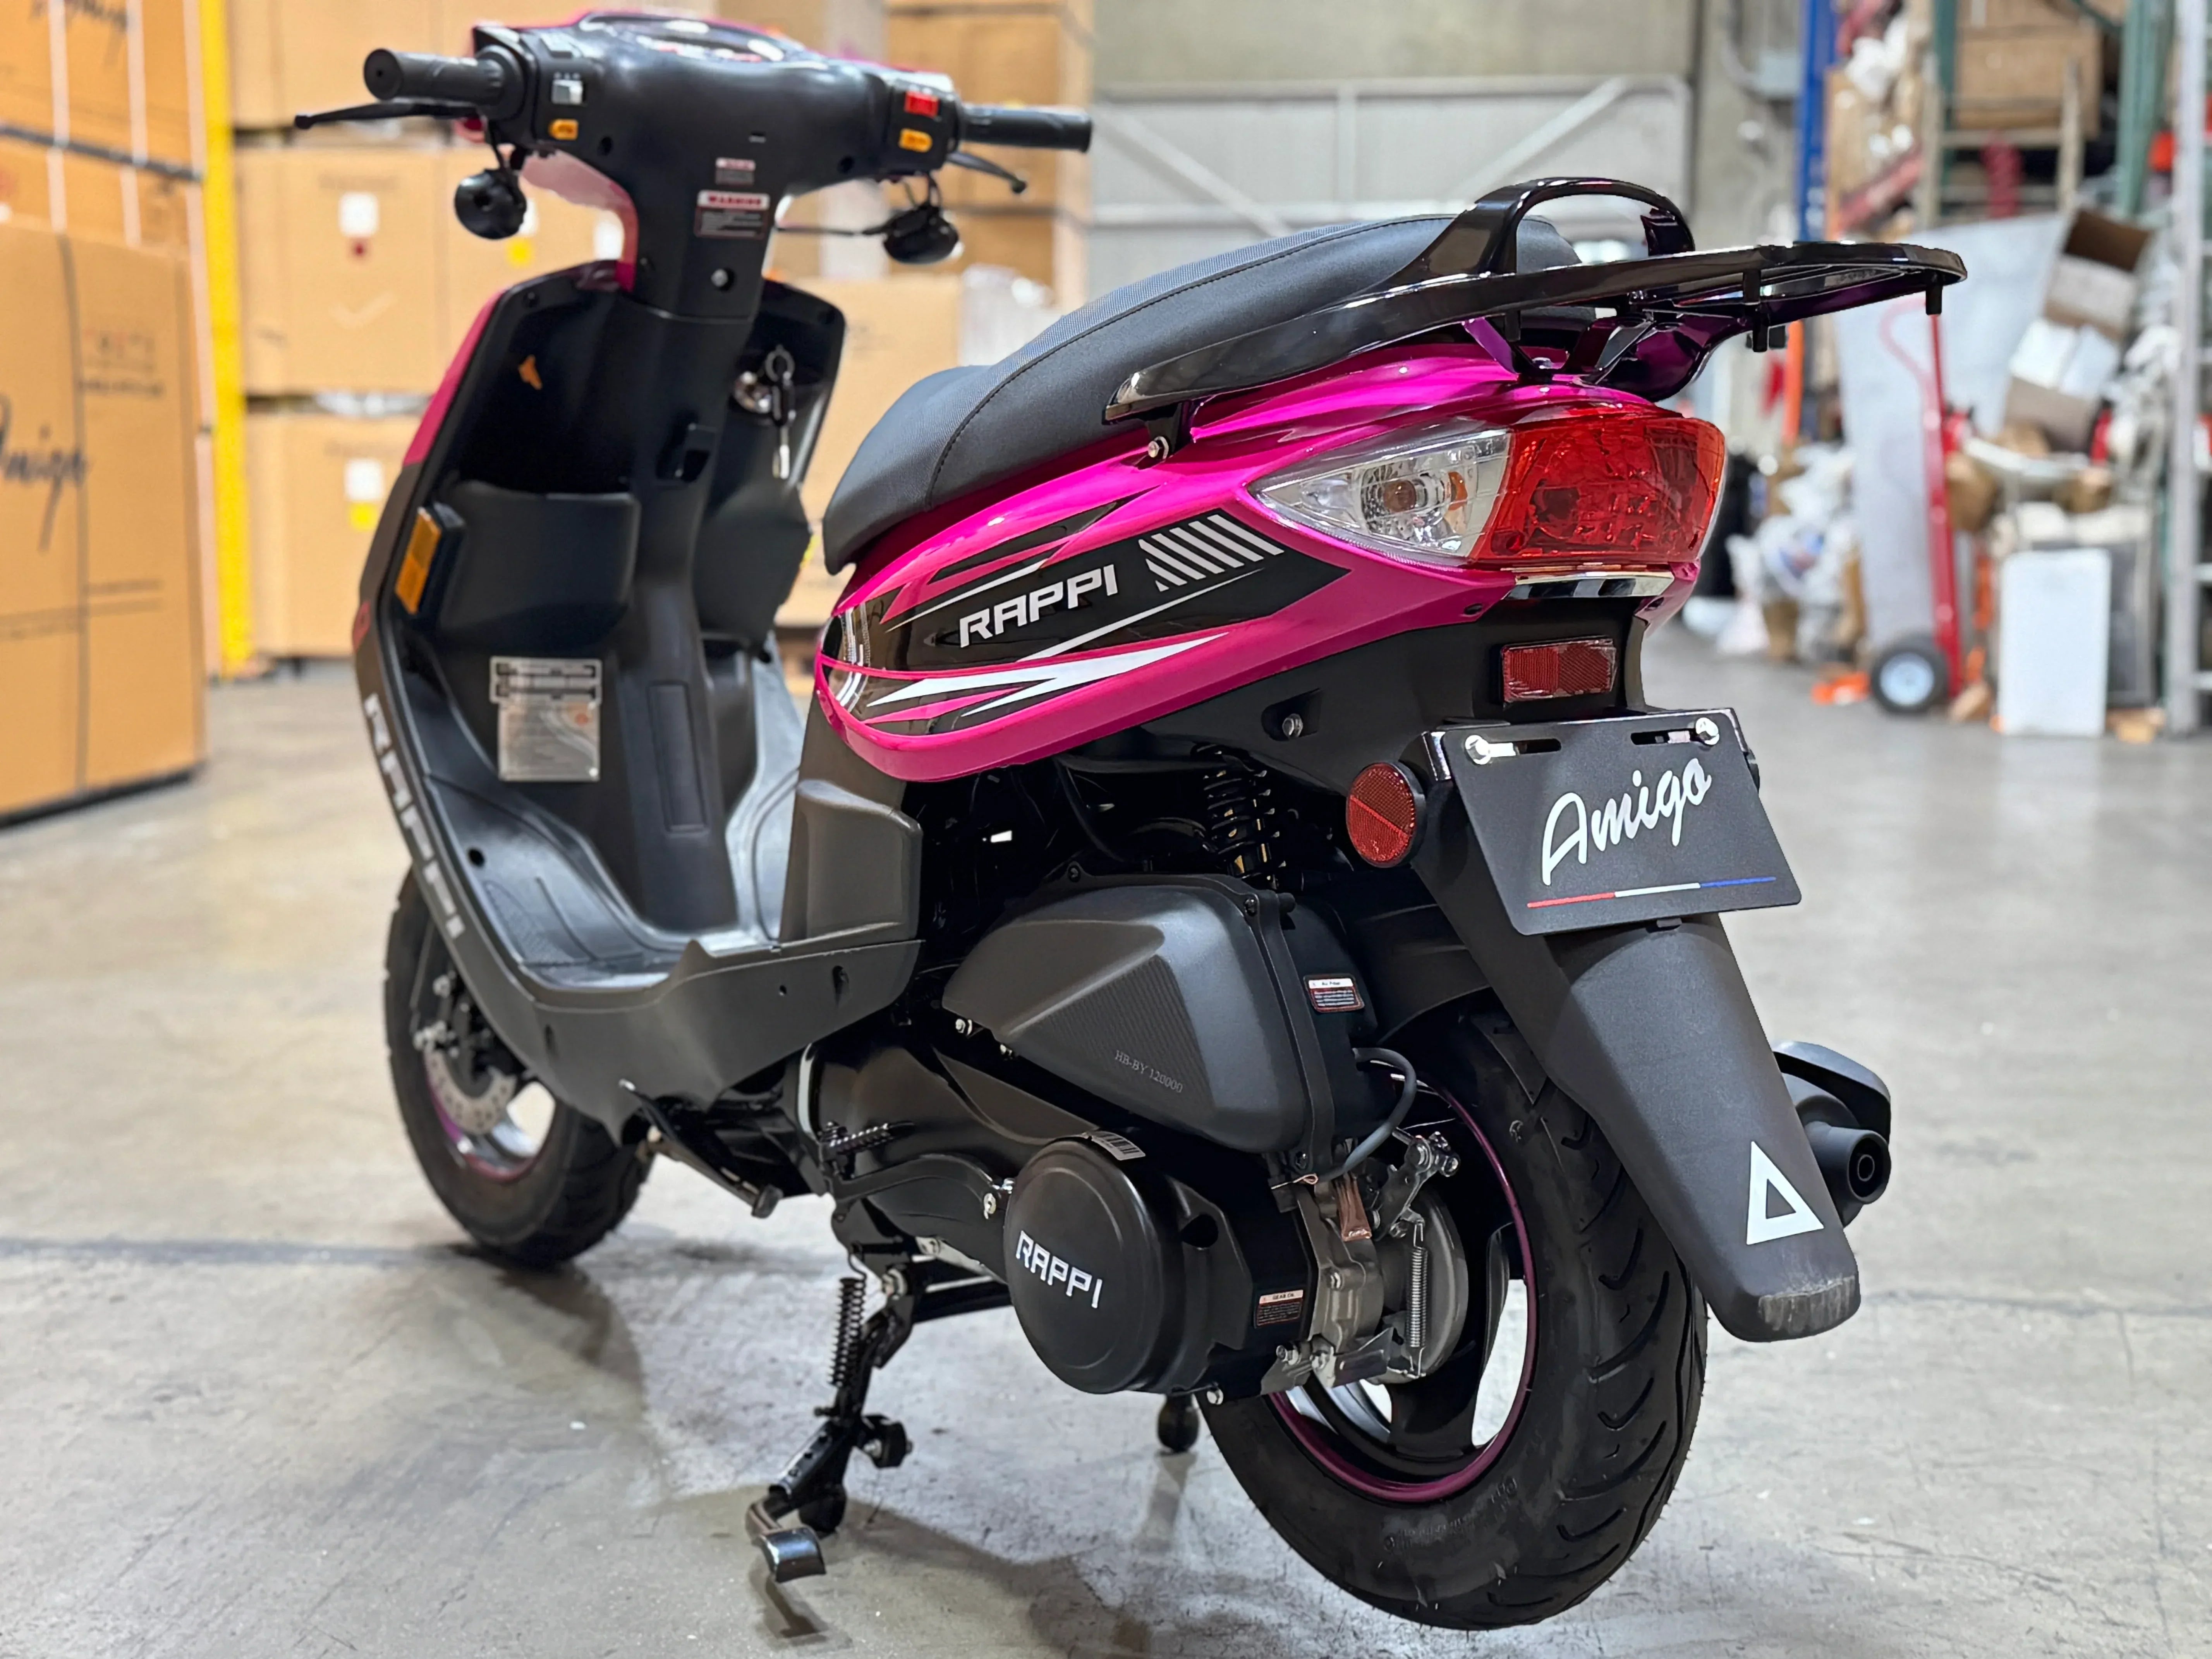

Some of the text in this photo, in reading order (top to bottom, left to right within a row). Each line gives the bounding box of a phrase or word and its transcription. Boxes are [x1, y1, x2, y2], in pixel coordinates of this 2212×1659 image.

[960, 564, 1118, 648] RAPPI
[1542, 758, 1712, 885] Amigo
[1115, 1050, 1148, 1074] HB-BY
[1016, 1230, 1103, 1308] RAPPI
